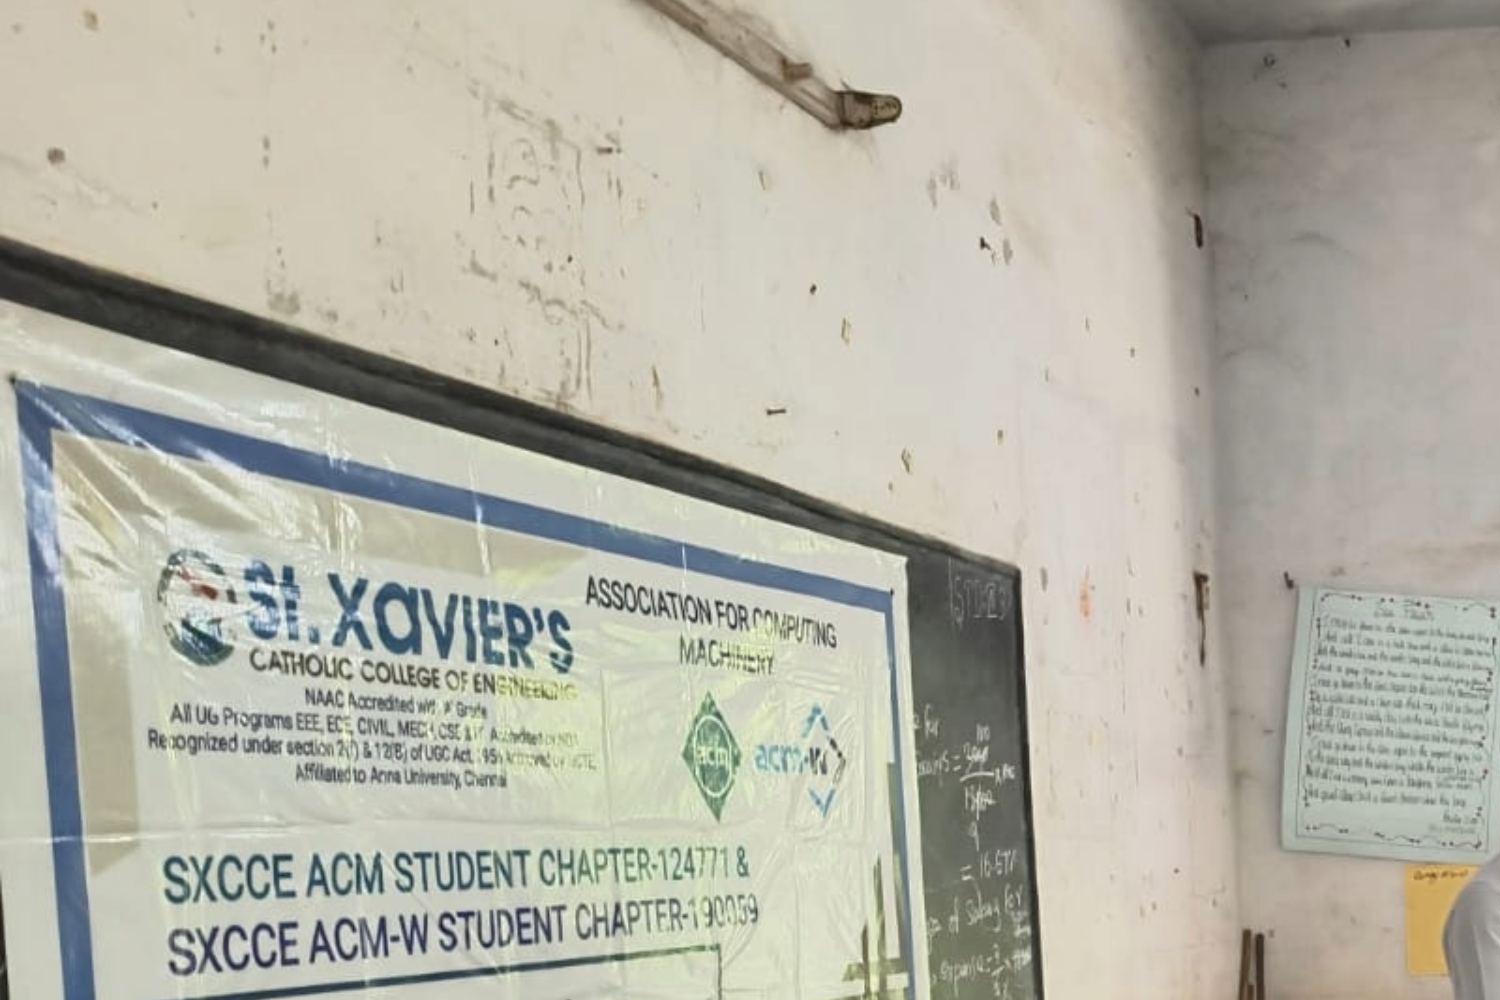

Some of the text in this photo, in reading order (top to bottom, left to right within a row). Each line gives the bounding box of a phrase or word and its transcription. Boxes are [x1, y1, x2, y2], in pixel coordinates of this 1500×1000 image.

[586, 575, 838, 648] ASSOCIATION FOR COMPUTING
[250, 648, 354, 680] CATHOLIC
[360, 659, 441, 689] COLLEGE
[445, 670, 468, 693] OF
[679, 636, 775, 675] MACHINERY
[196, 707, 219, 726] UG
[223, 707, 293, 733] Programs
[304, 687, 344, 709] NAAC
[348, 692, 414, 715] Accredited
[242, 736, 283, 756] under
[287, 740, 335, 759] section
[410, 747, 421, 763] of
[425, 747, 450, 764] UGC
[353, 767, 366, 783] to
[370, 766, 400, 785] Anna
[163, 845, 749, 904] SXCCE ACM STUDENT CHAPTER-124771 &
[168, 921, 300, 977] SXCCE
[309, 912, 428, 965] ACM-W
[438, 904, 567, 952] STUDENT
